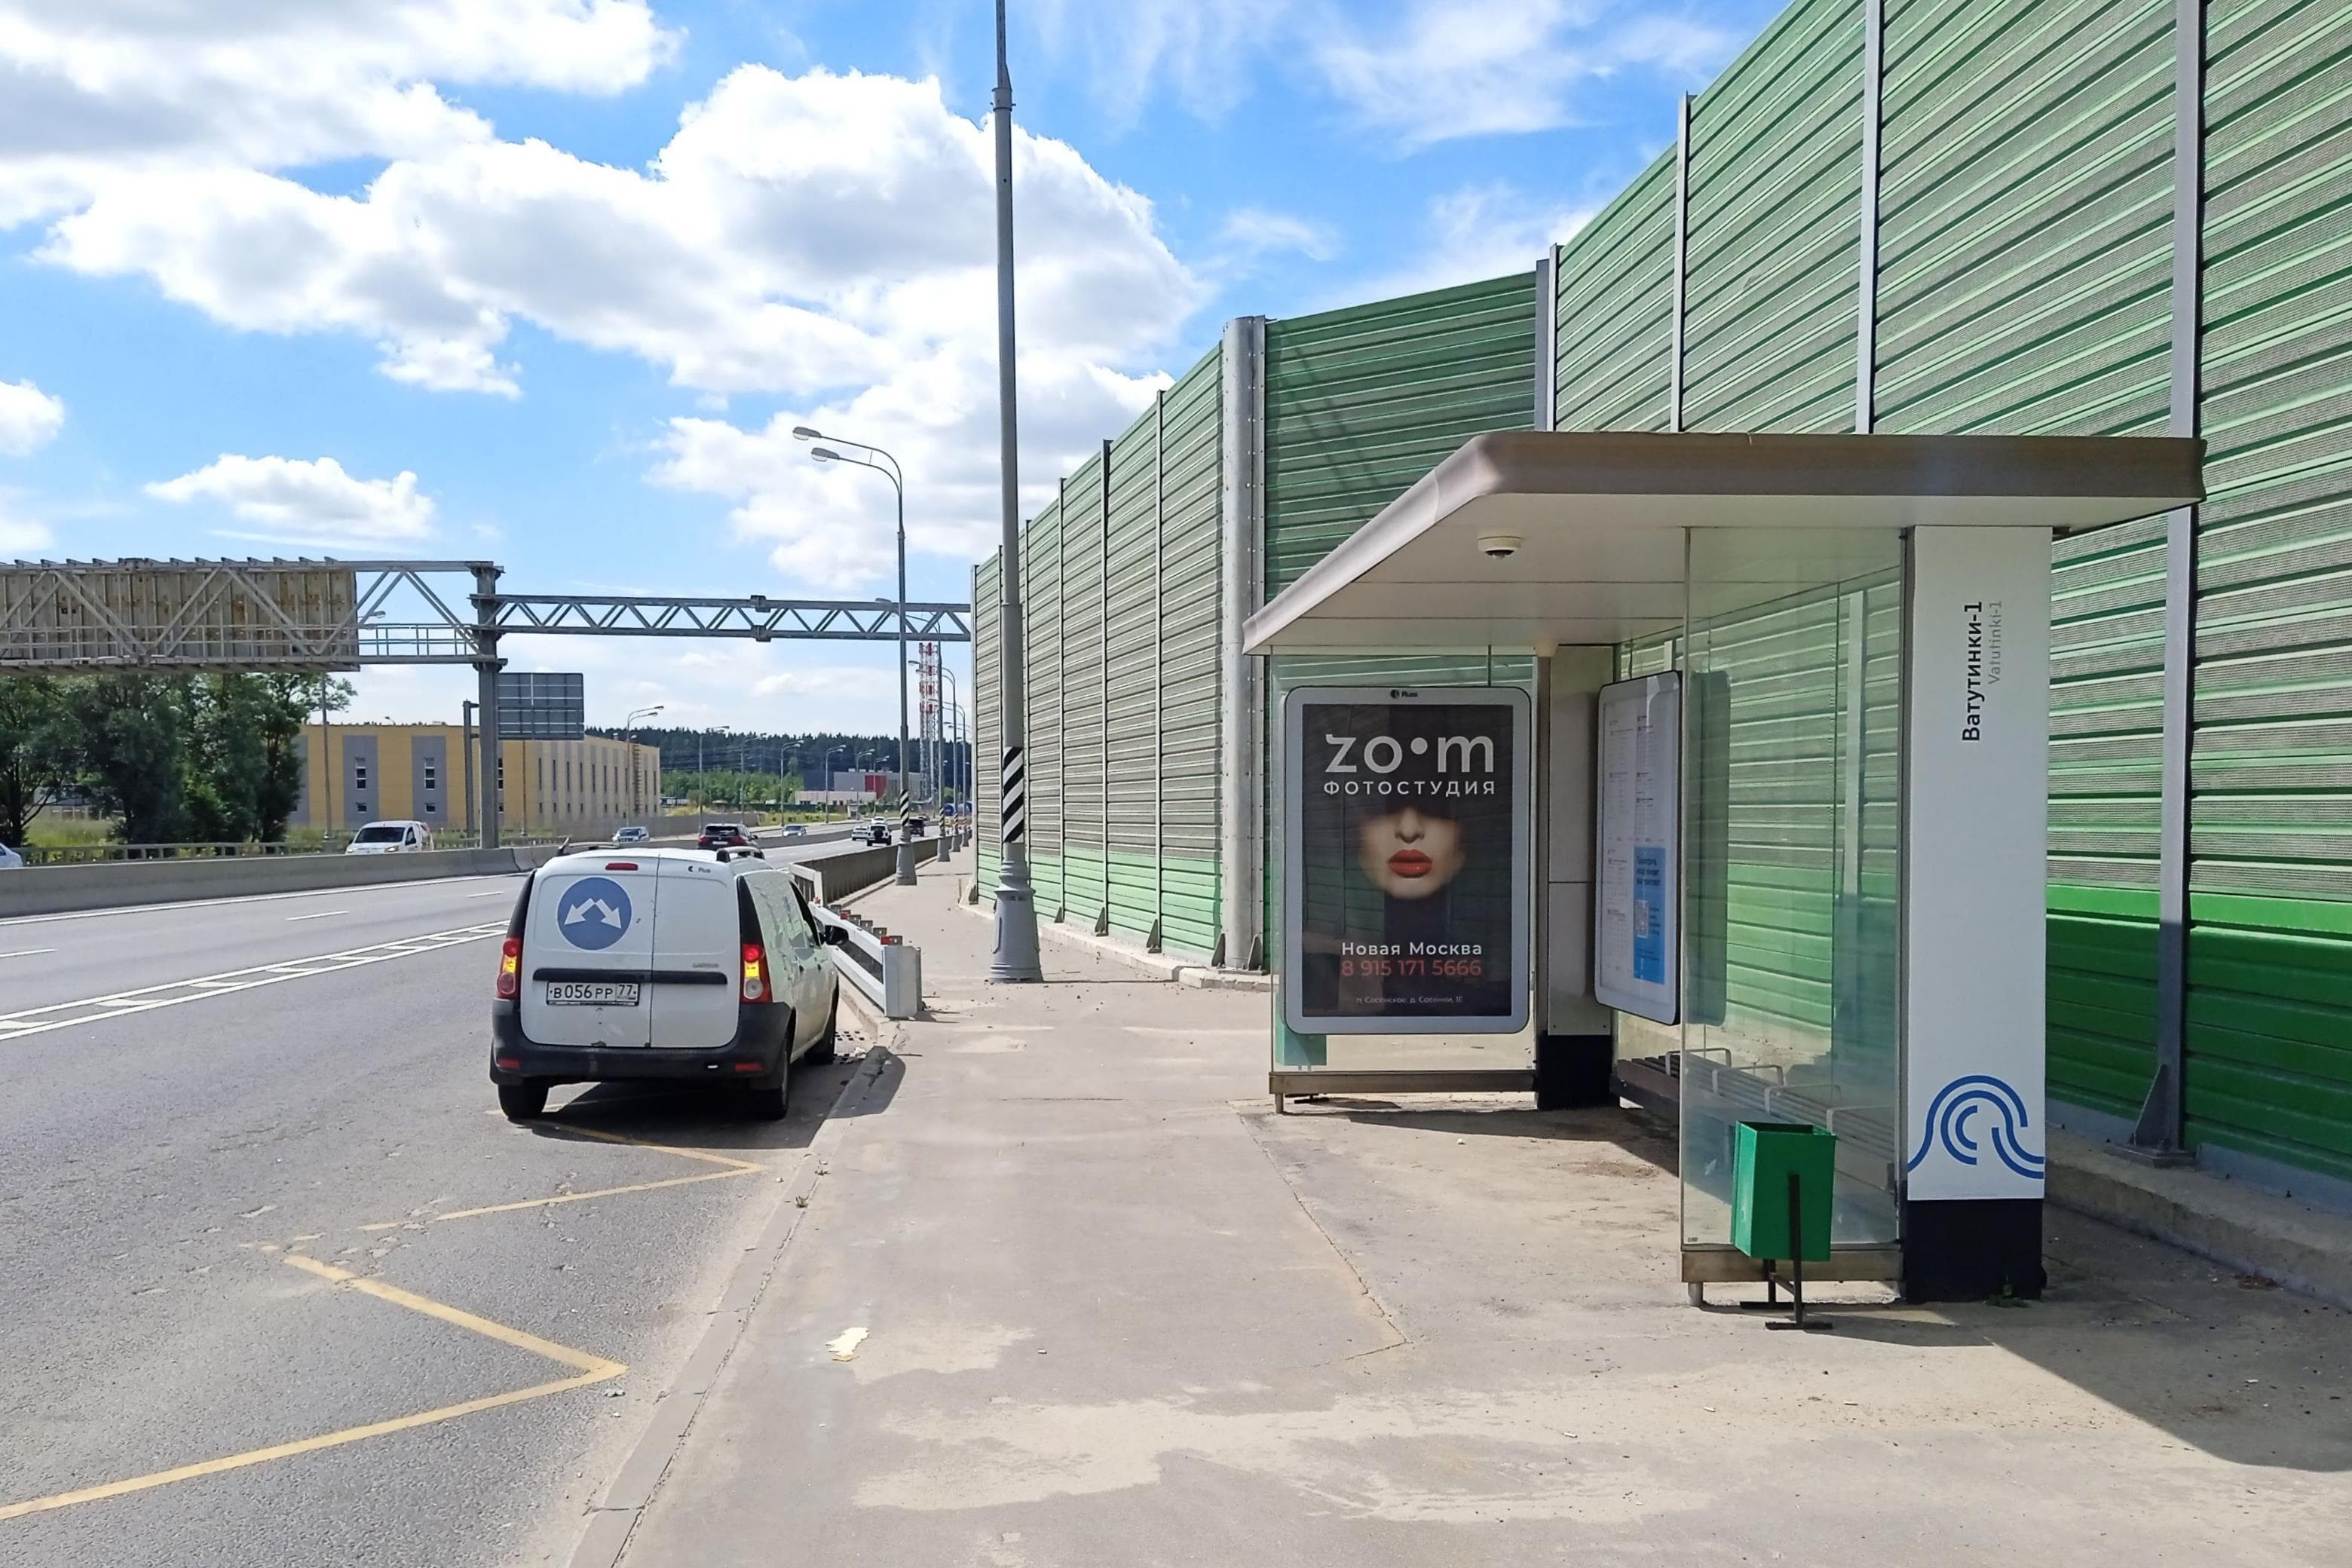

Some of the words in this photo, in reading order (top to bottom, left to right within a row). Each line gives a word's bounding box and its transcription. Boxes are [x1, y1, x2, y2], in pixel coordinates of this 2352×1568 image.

[1988, 601, 2002, 684] Vatutinki-1
[1962, 601, 1985, 742] Ватутинки-1
[1323, 780, 1495, 798] ФОТОСТУДИЯ
[1341, 942, 1401, 956] Новая
[1409, 942, 1483, 956] Москва
[1341, 960, 1354, 976] 8
[1360, 960, 1392, 976] 915
[1398, 960, 1425, 976] 171
[1432, 959, 1483, 976] 5666
[618, 985, 633, 996] 77
